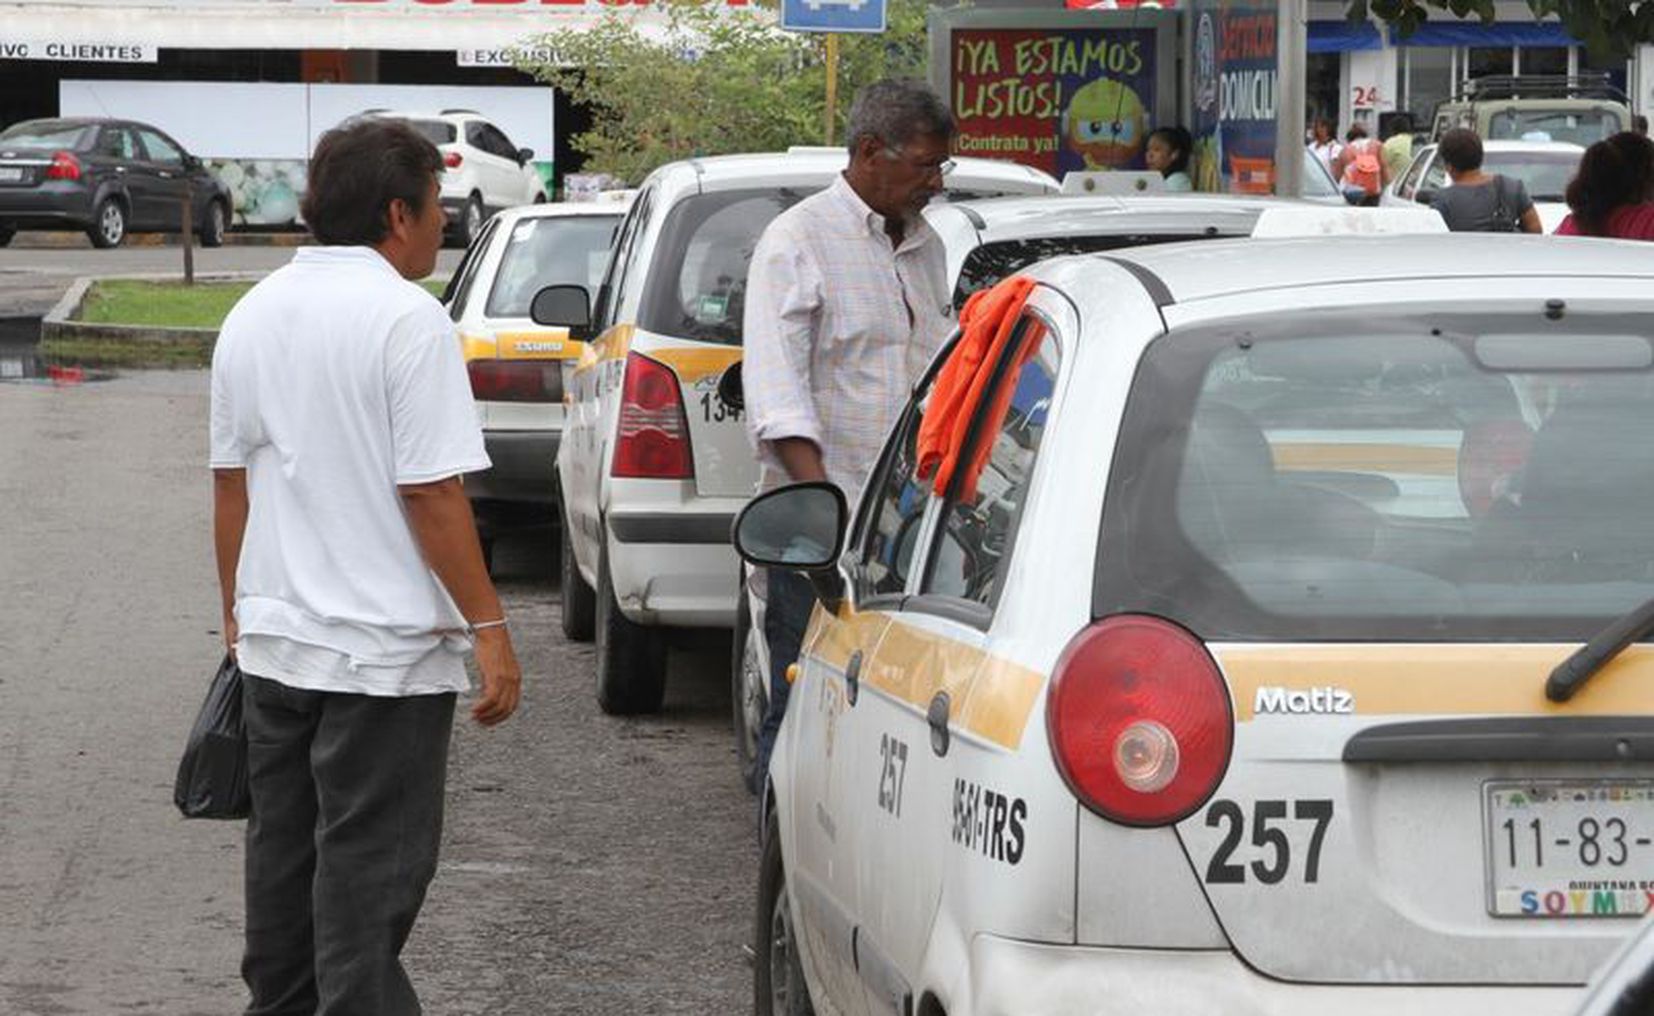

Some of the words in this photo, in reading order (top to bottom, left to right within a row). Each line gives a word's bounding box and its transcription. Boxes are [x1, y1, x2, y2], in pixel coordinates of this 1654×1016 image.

[46, 44, 142, 59] CLIENTES
[1015, 36, 1142, 77] ESTAMOS
[956, 78, 1062, 119] LISTOS!
[1219, 69, 1279, 121] DOMICILI
[1353, 86, 1377, 105] 24
[1034, 134, 1060, 154] ya!
[1254, 686, 1354, 715] Matiz
[879, 732, 908, 819] 257
[1205, 799, 1334, 885] 257
